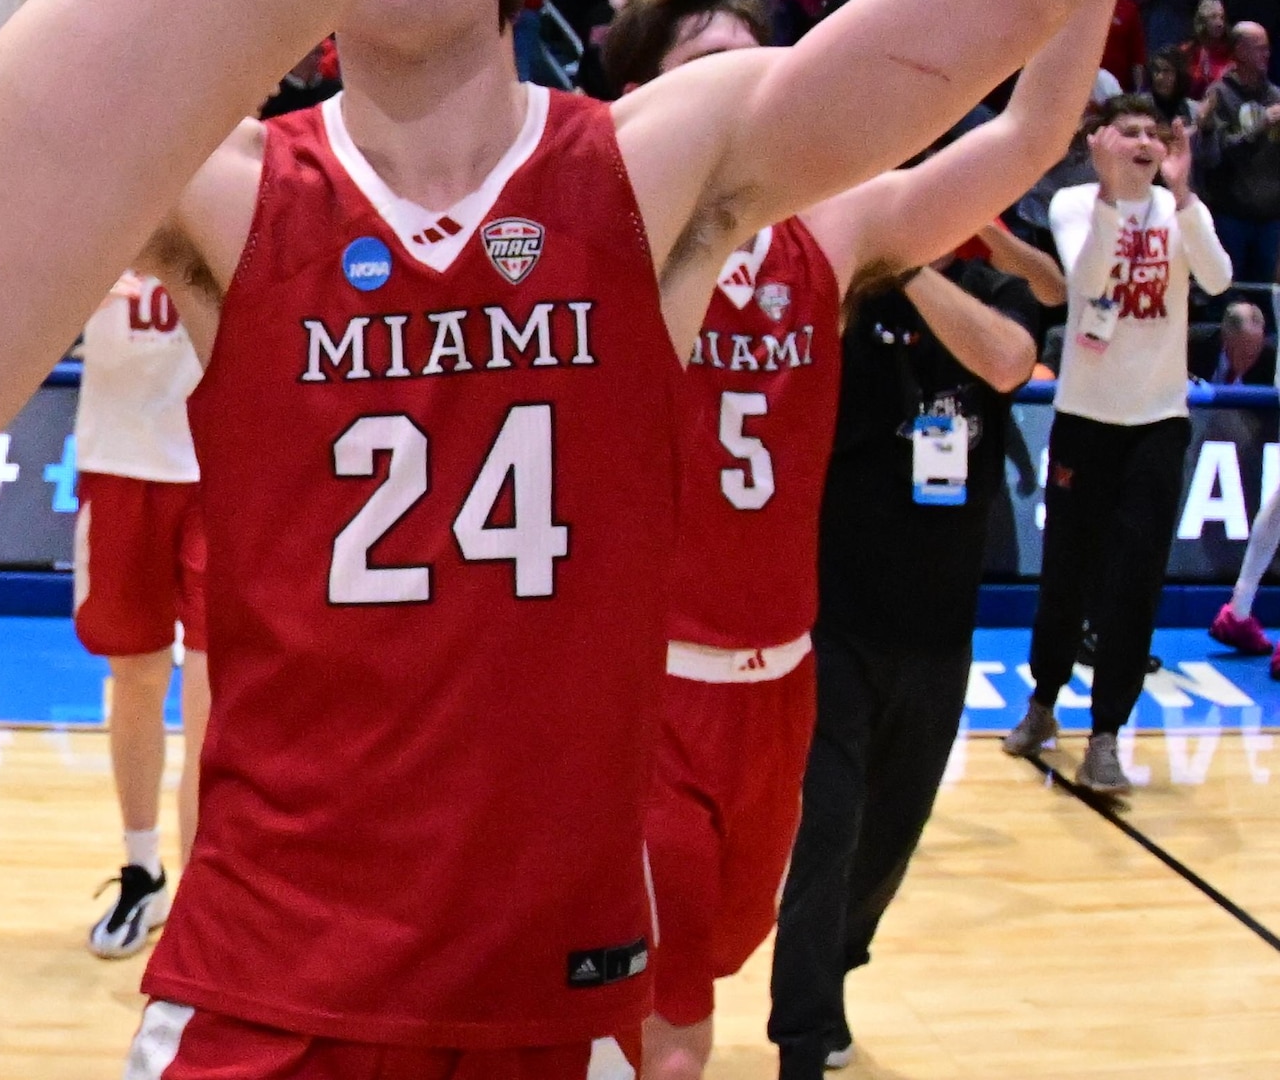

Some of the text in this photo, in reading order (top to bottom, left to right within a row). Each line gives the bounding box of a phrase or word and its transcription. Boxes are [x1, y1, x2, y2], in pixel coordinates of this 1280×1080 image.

[489, 238, 539, 257] MAC
[300, 299, 597, 383] MIAMI
[718, 389, 777, 511] 5
[326, 402, 571, 606] 24
